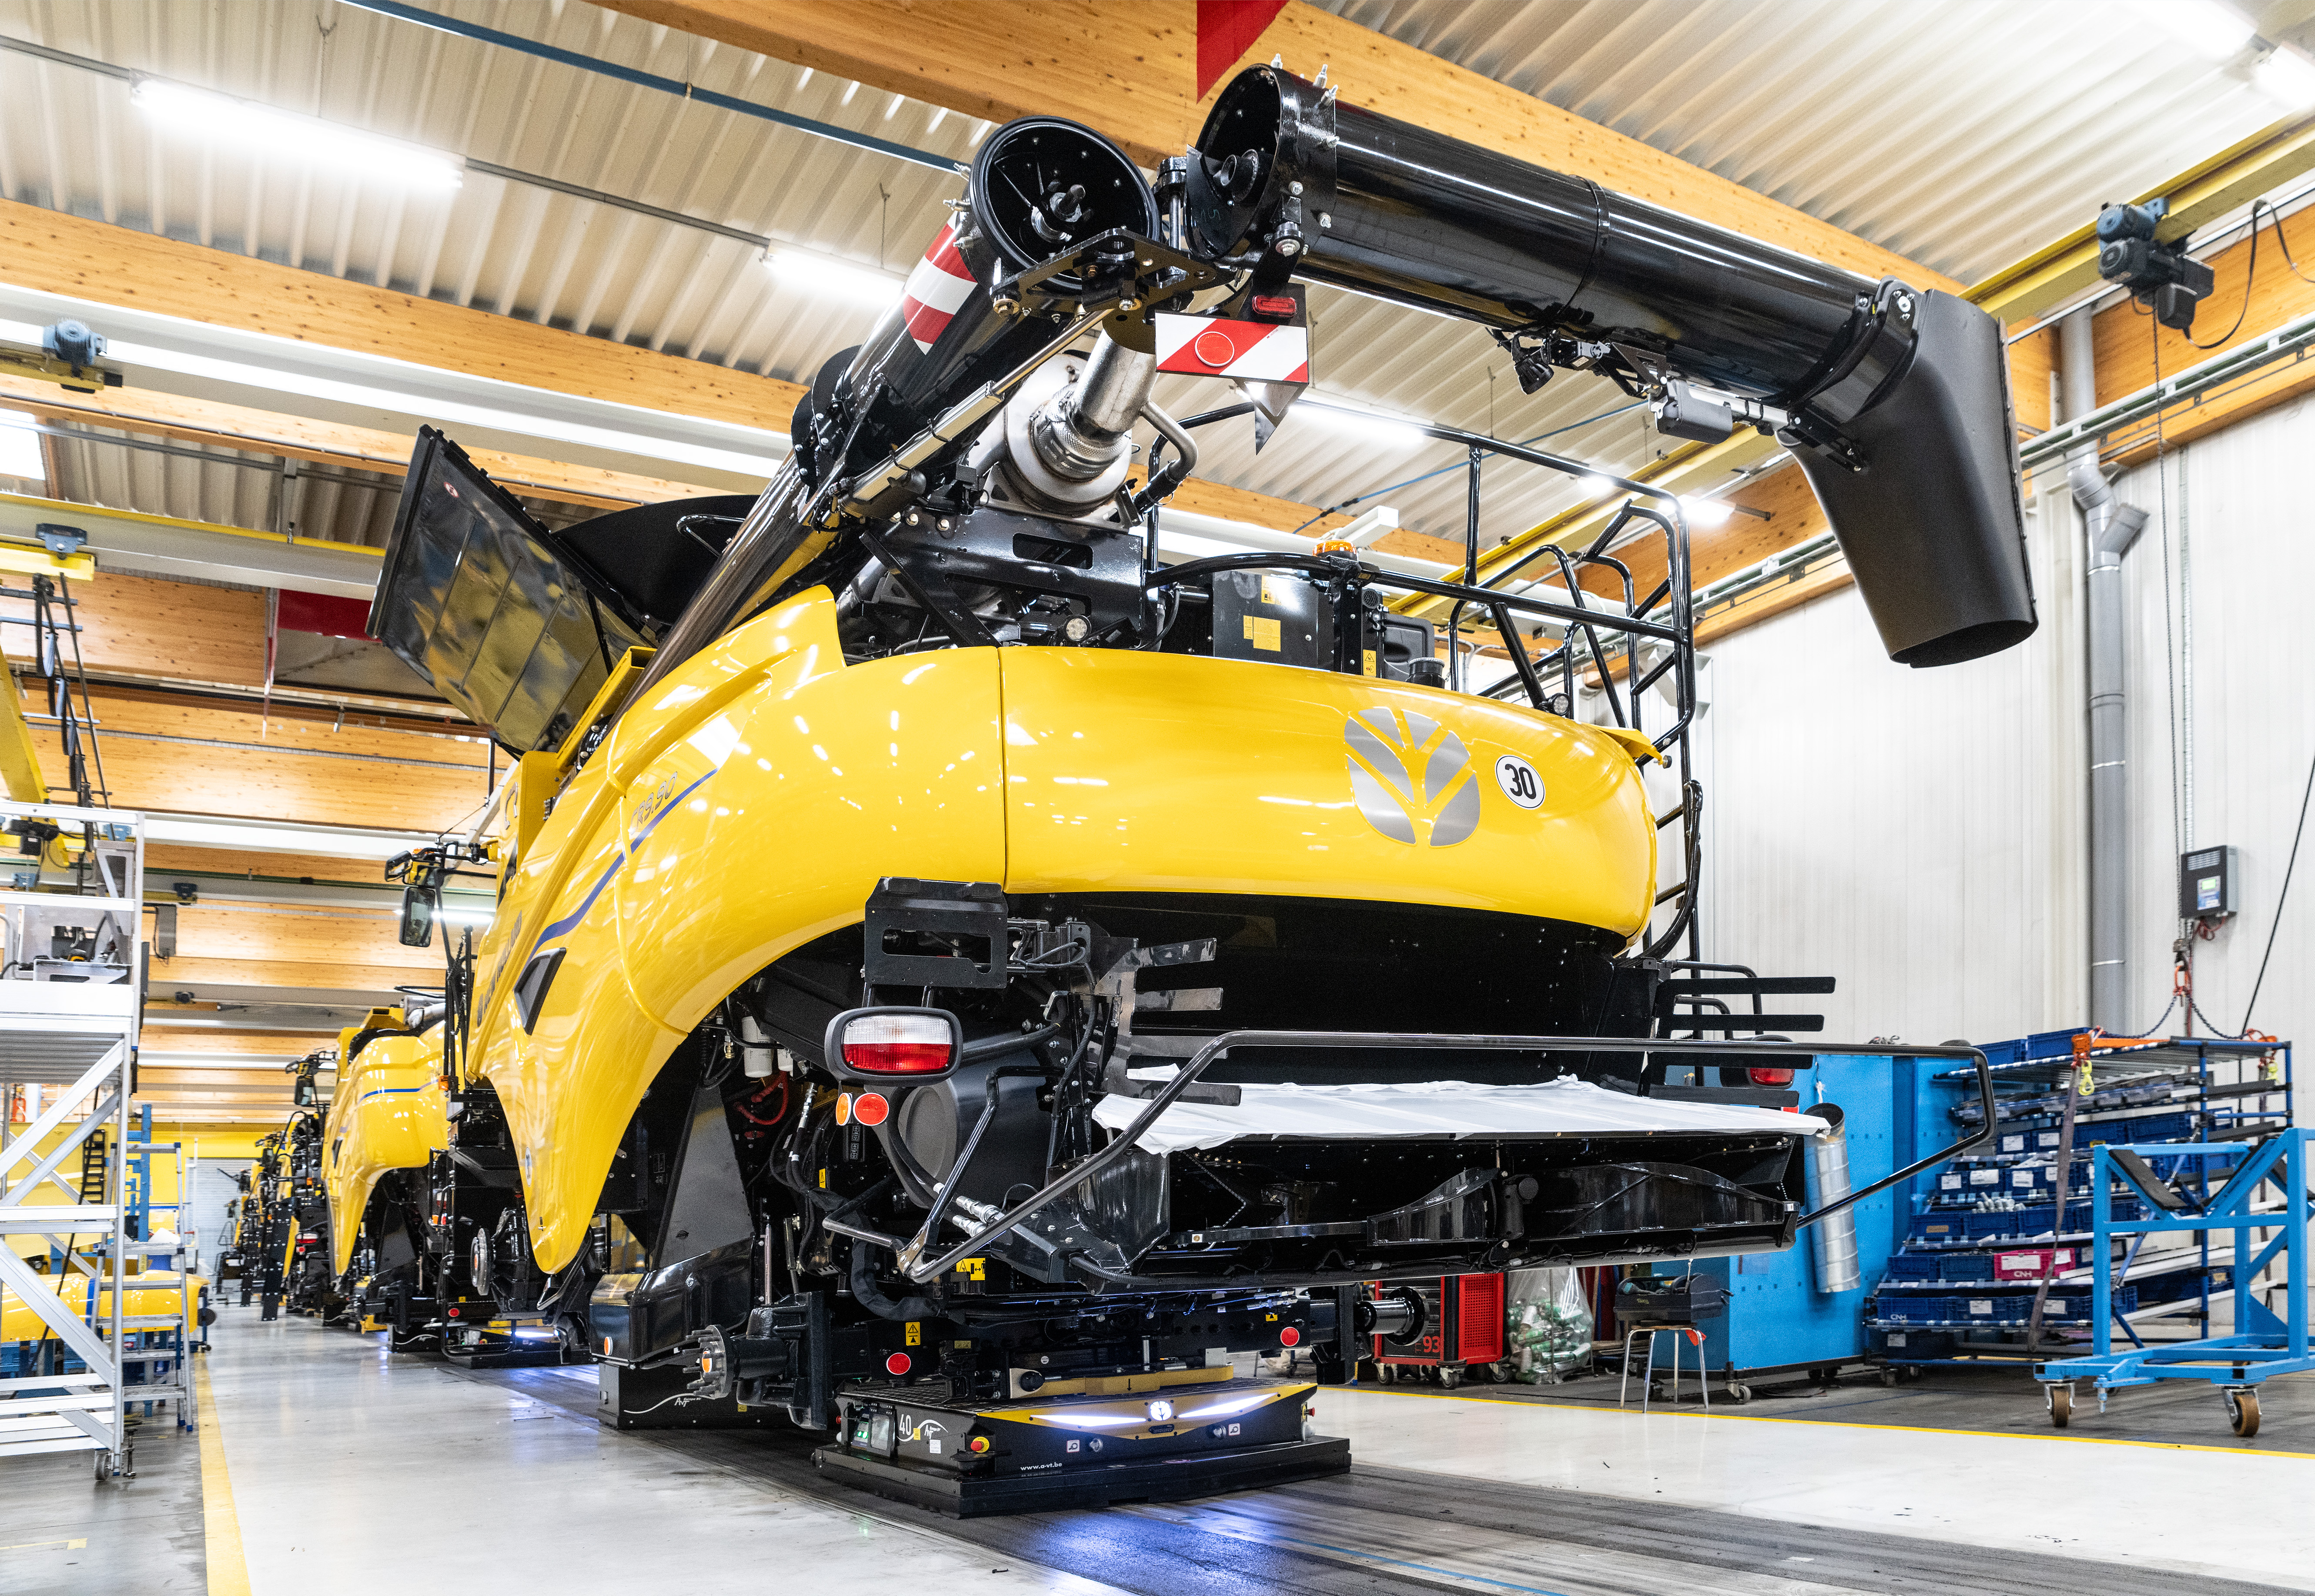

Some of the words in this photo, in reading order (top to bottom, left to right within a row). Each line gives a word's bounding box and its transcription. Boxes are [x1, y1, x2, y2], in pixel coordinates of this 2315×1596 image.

[1505, 763, 1536, 800] 30
[628, 771, 677, 835] CR9.90
[1423, 1336, 1441, 1353] 93
[899, 1414, 911, 1435] 40
[1020, 1462, 1062, 1471] www.a-vt.be
